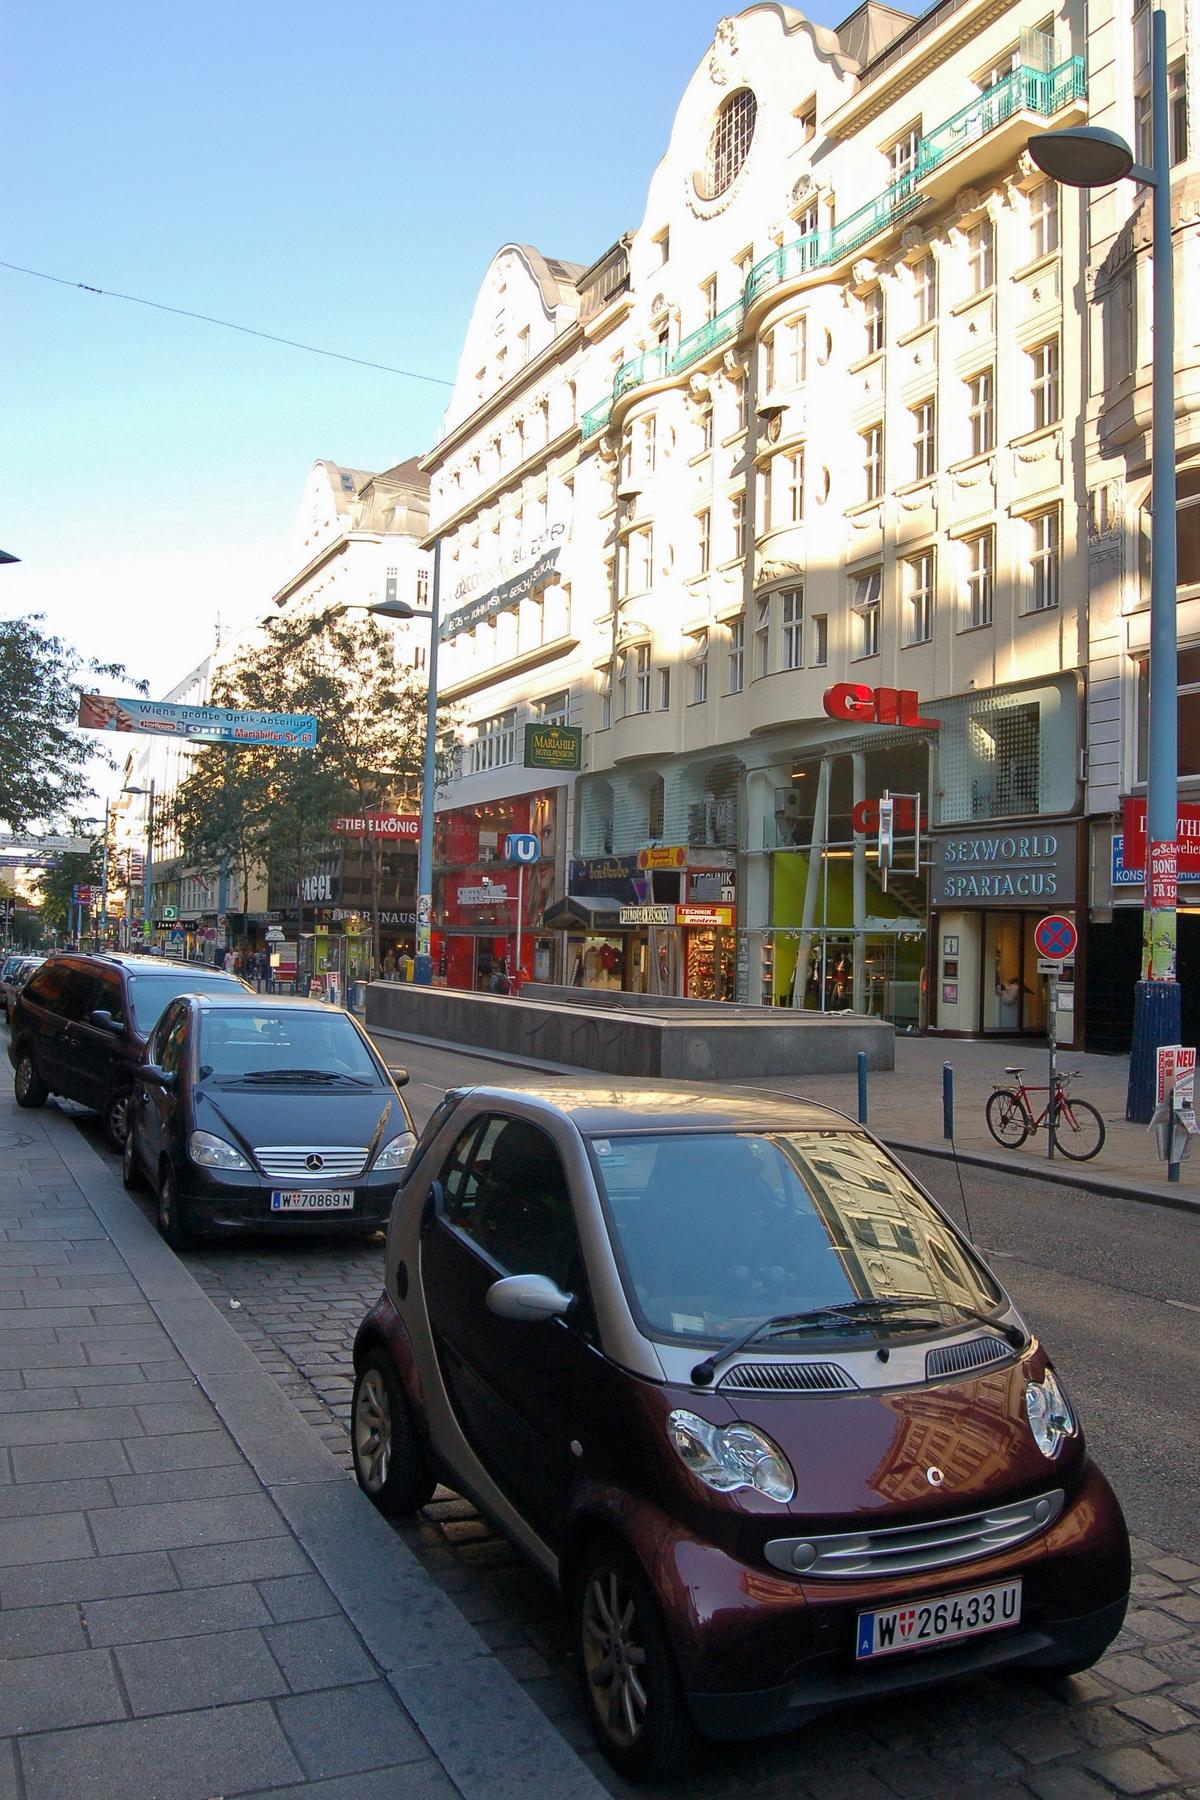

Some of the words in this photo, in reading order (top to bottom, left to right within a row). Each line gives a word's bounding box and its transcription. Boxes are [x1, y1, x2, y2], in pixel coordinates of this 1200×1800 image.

[823, 682, 940, 729] GIL
[140, 704, 175, 716] Wiens
[226, 713, 312, 730] Optik-Abteilung
[235, 728, 283, 741] Mariahilfer
[518, 840, 535, 860] U
[944, 835, 1057, 861] SEXWORLD
[944, 872, 1057, 897] SPARTACUS
[1153, 884, 1165, 896] FR
[1176, 1050, 1195, 1068] NEU
[282, 1194, 291, 1207] W
[301, 1194, 340, 1207] 70869
[343, 1194, 350, 1206] N
[878, 1614, 897, 1647] W
[917, 1593, 996, 1639] 26433
[1002, 1588, 1016, 1618] U
[862, 1639, 870, 1649] A
